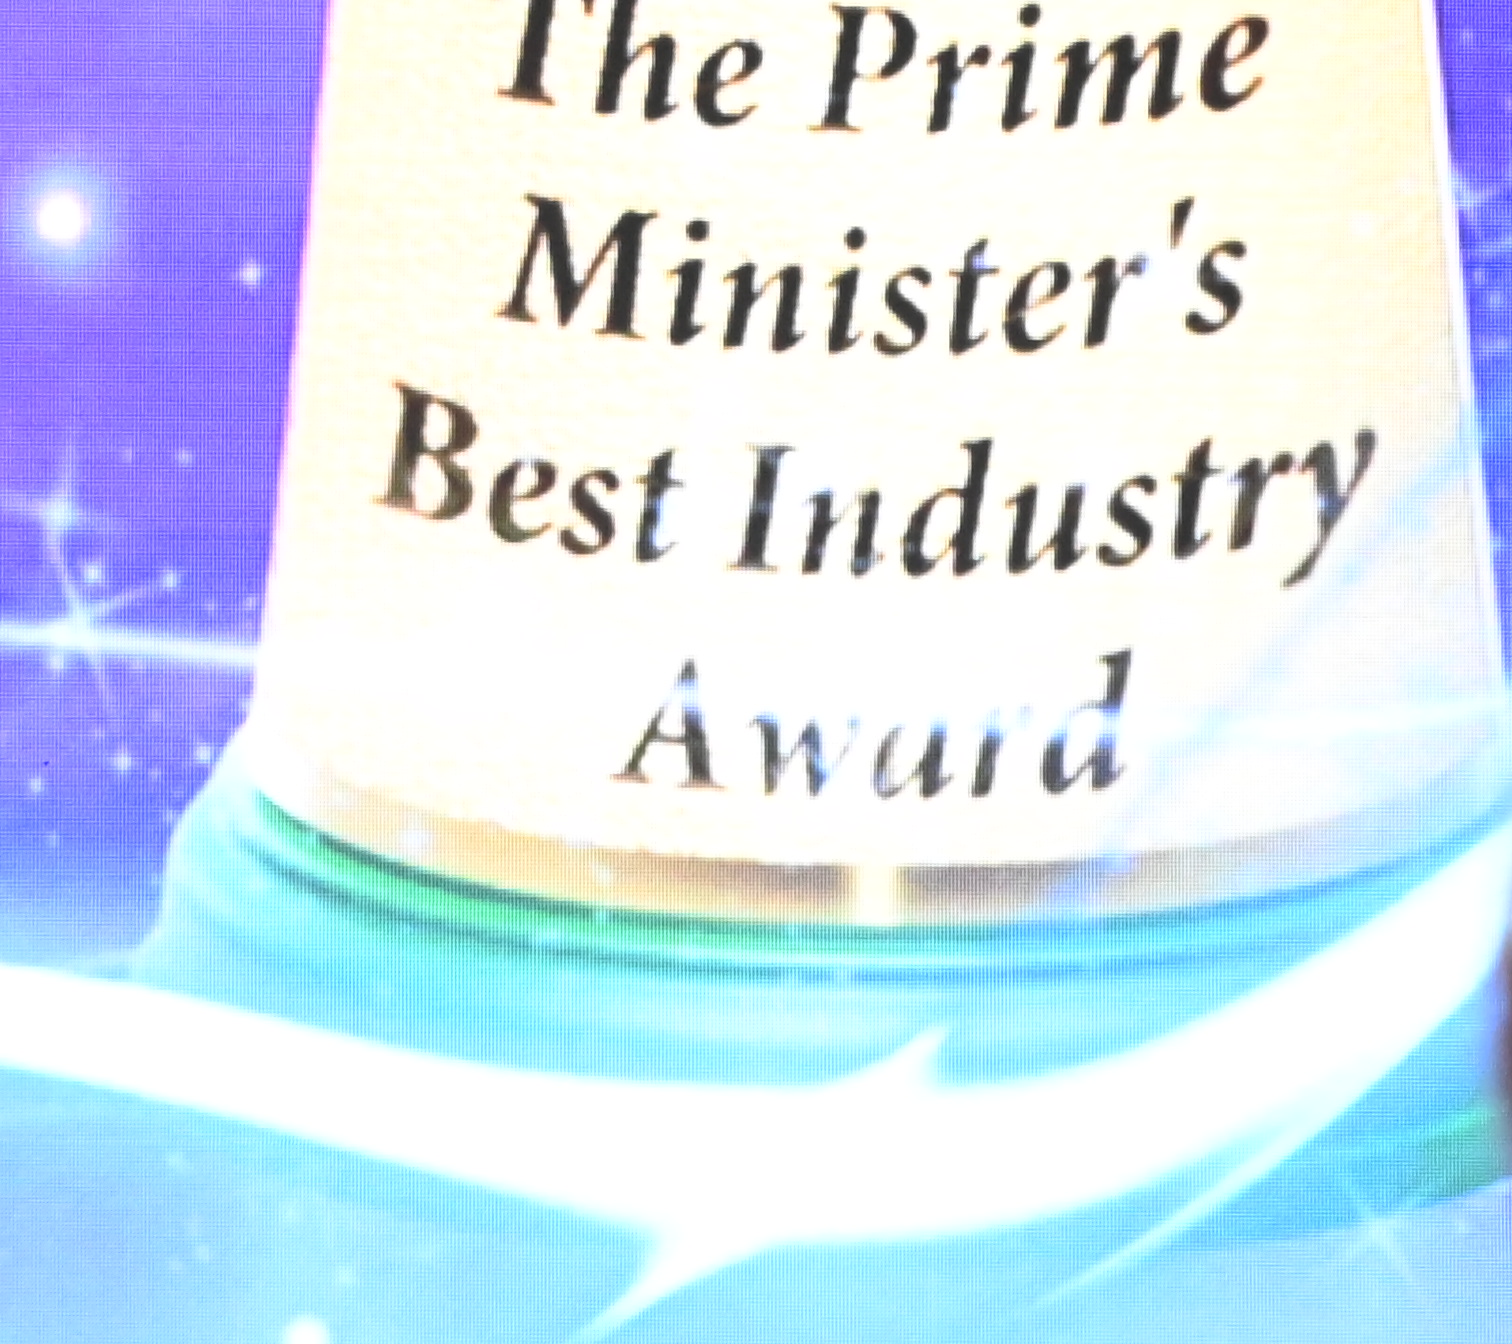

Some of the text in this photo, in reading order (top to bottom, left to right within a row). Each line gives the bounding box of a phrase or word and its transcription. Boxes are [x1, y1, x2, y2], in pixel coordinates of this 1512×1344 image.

[809, 2, 1270, 134] Prime
[496, 192, 1248, 357] Minister's
[374, 380, 1377, 588] Best Industry
[612, 646, 1133, 799] Award
